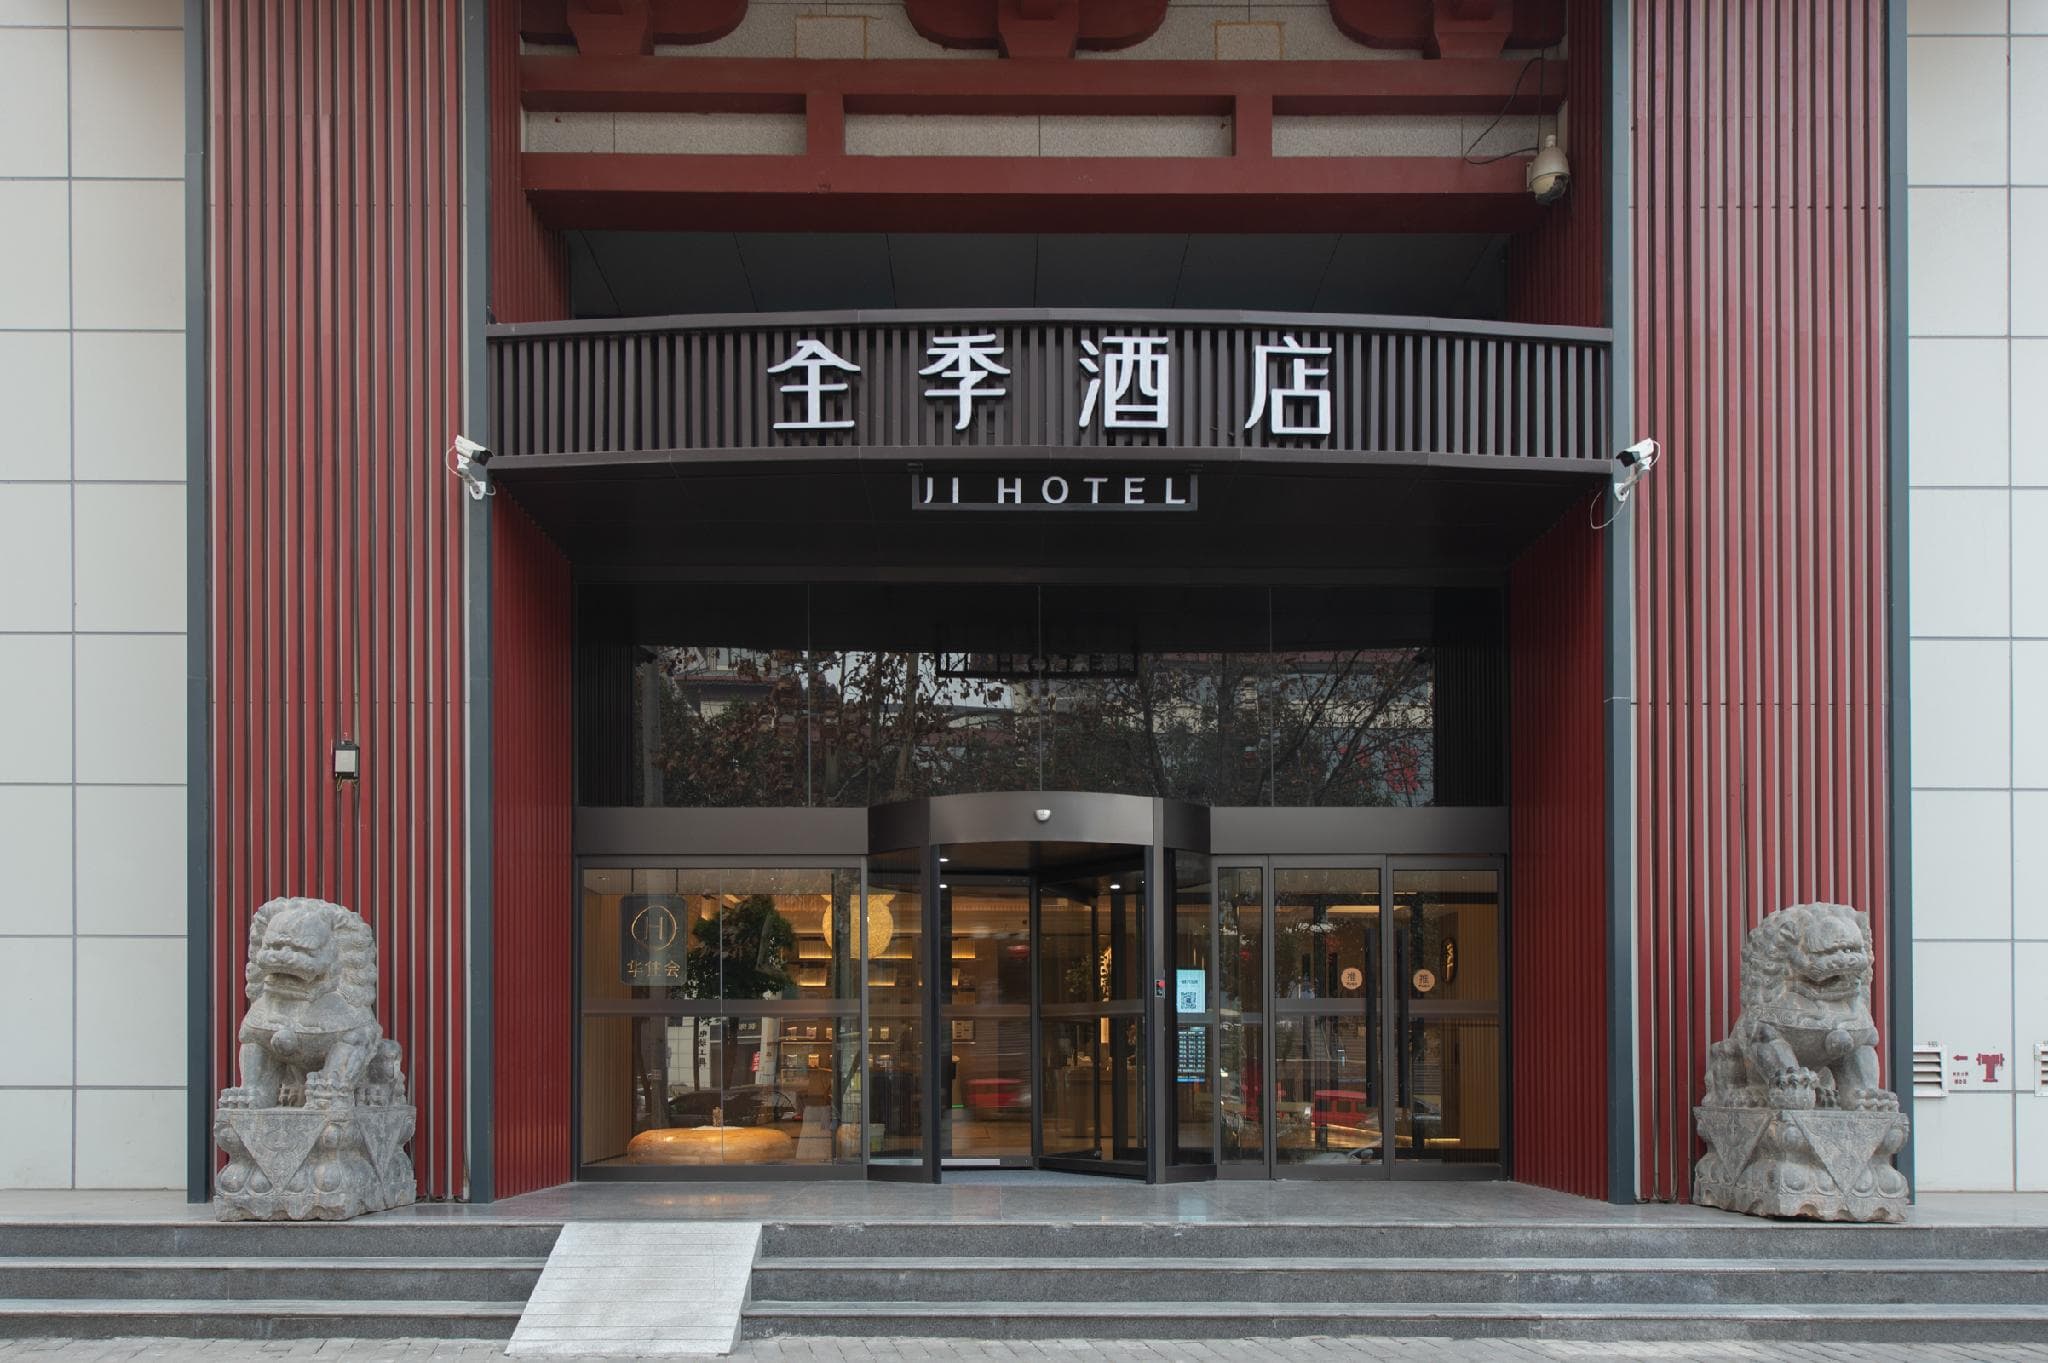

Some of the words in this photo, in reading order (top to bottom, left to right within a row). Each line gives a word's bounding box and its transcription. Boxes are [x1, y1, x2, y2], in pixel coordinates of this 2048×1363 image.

[767, 334, 1333, 434] 全季酒店
[923, 477, 959, 504] JI
[997, 476, 1187, 504] HOTEL
